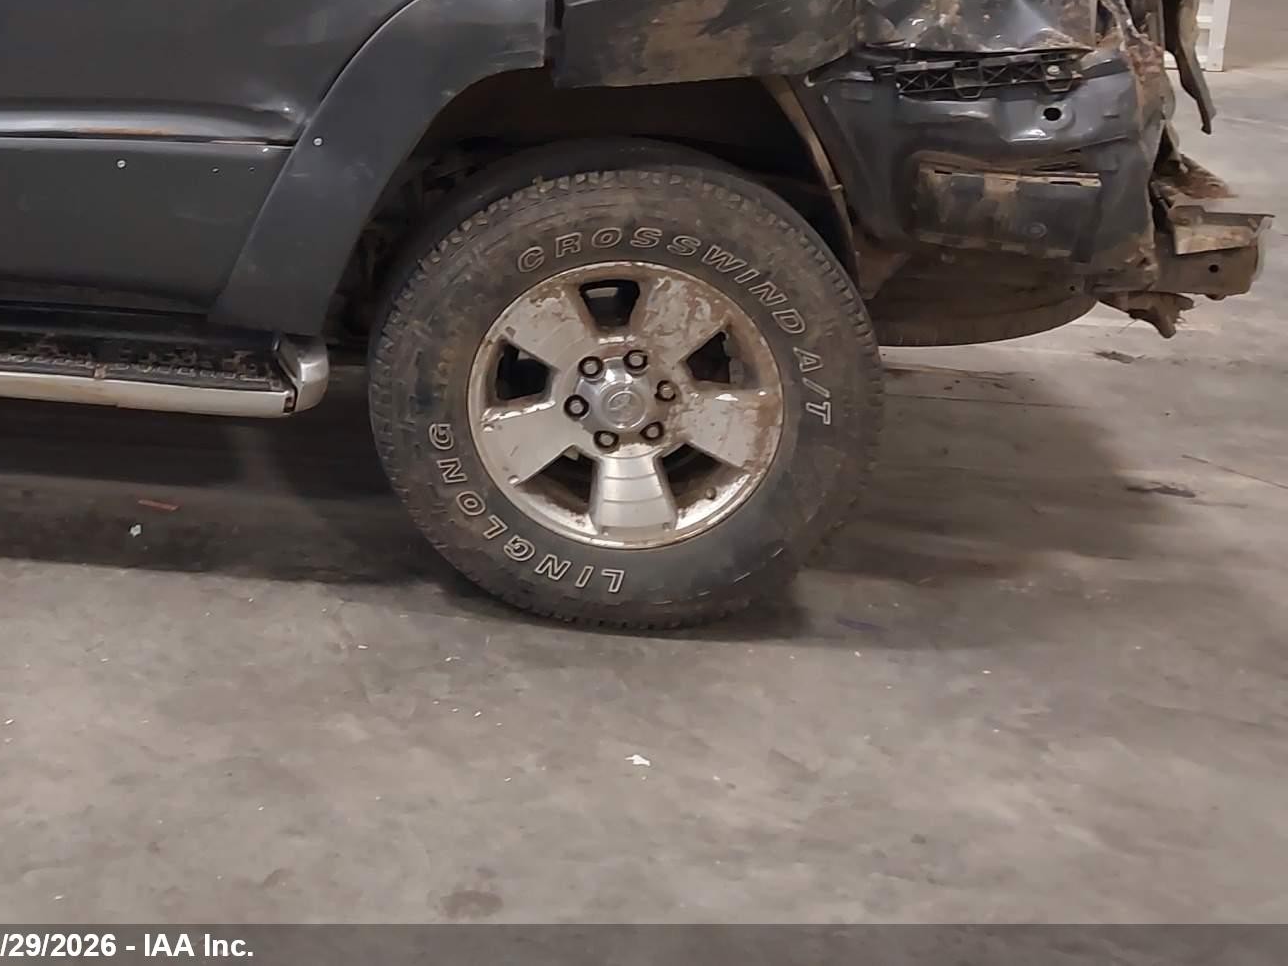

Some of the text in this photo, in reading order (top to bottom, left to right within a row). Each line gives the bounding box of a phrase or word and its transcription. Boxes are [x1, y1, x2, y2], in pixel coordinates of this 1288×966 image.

[516, 227, 831, 425] CROSSWIND A/T
[428, 422, 626, 594] LINGLONG
